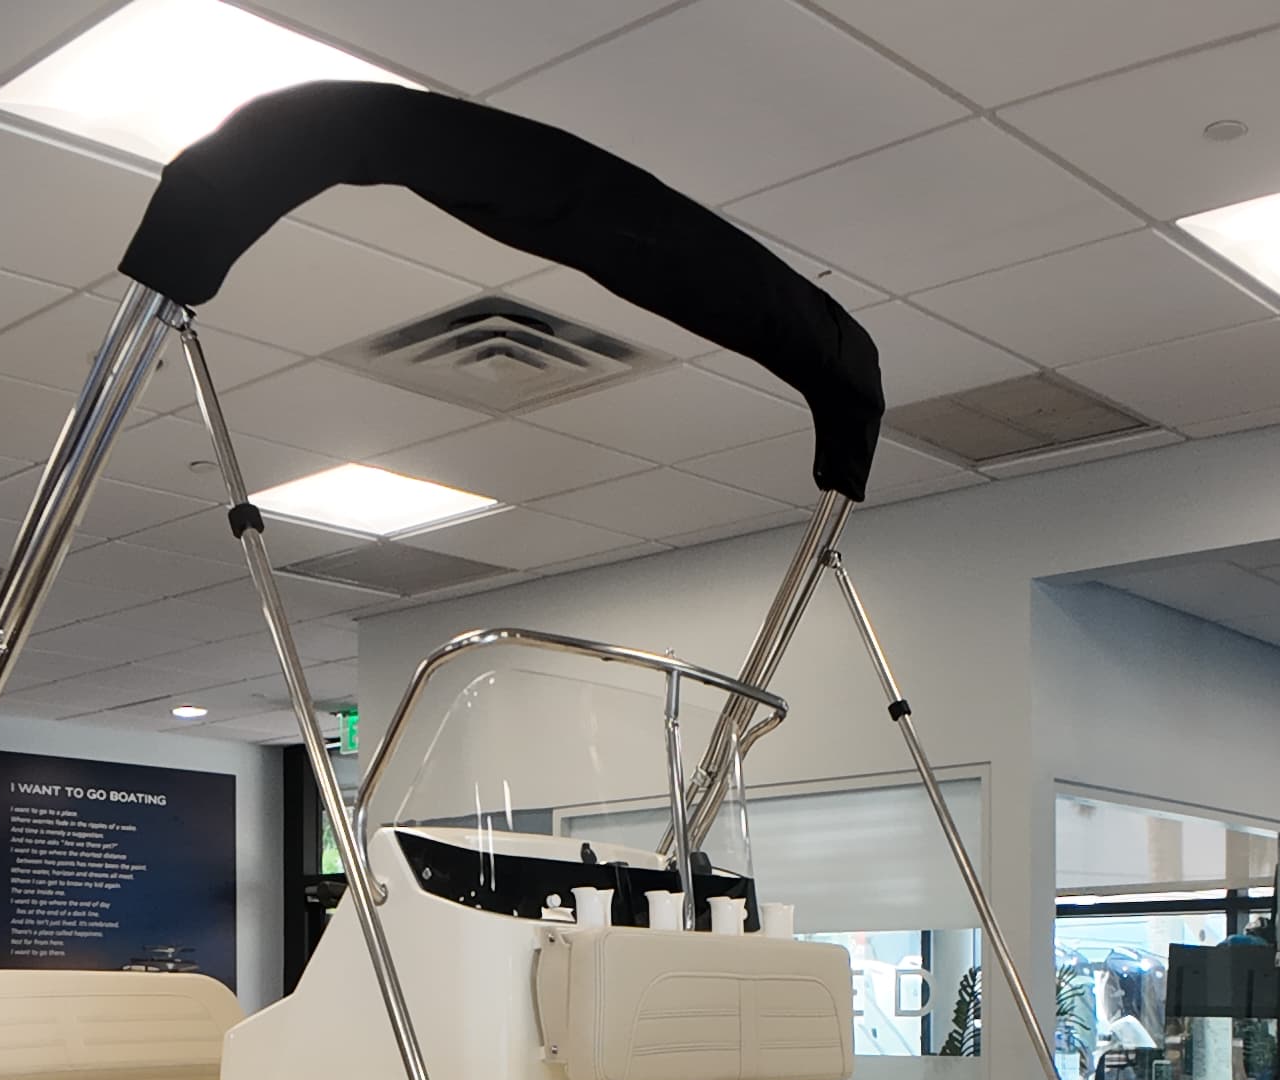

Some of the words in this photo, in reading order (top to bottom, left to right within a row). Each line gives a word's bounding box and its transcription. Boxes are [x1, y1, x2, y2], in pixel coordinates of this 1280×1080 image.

[10, 782, 15, 793] I
[17, 783, 61, 797] WANT
[65, 786, 84, 799] TO
[86, 788, 106, 801] GO
[109, 790, 167, 806] BOATING
